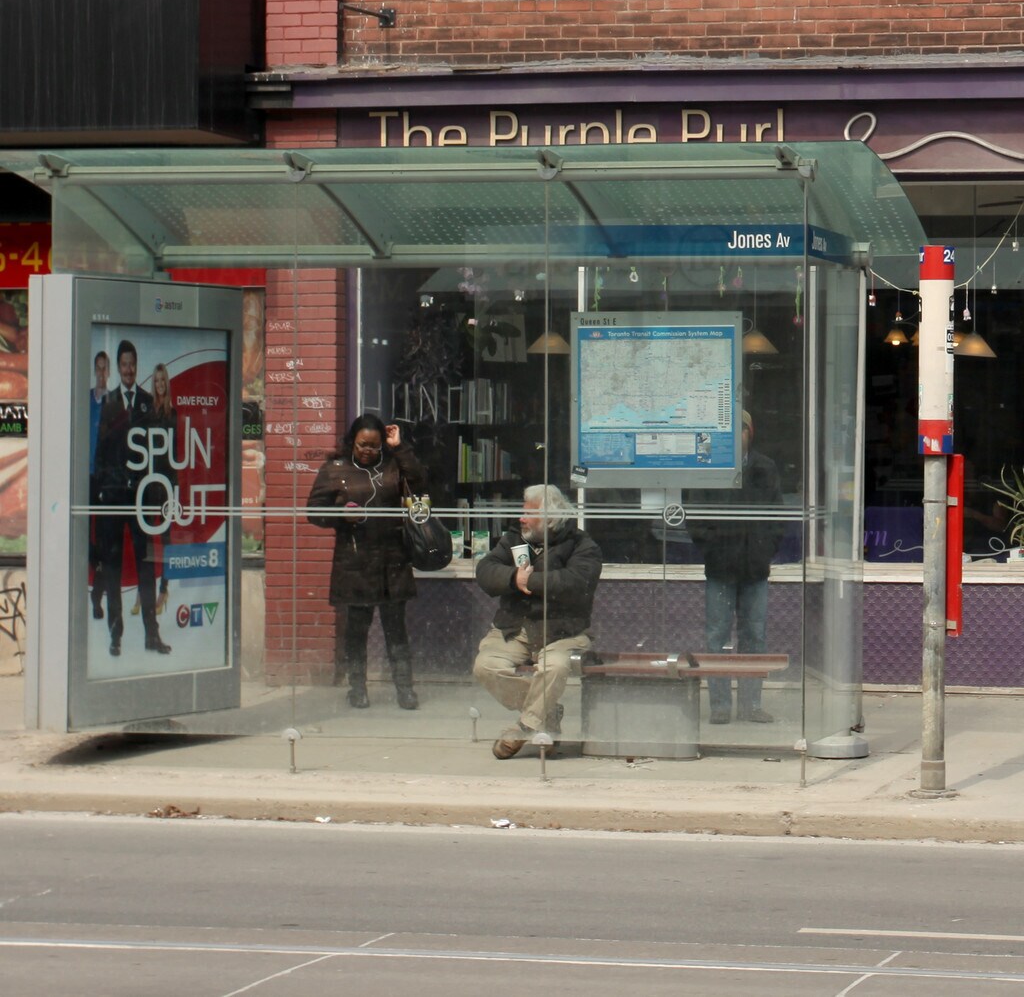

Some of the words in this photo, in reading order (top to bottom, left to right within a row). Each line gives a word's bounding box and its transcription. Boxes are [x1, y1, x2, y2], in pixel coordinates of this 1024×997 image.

[369, 111, 467, 147] The
[489, 109, 657, 146] Purple
[681, 108, 784, 143] Purl
[728, 230, 772, 249] Jones
[776, 234, 790, 248] Av
[811, 230, 822, 252] Jones
[164, 302, 182, 310] astral
[580, 318, 601, 326] Queen
[688, 331, 708, 339] System
[176, 396, 196, 406] DAVE
[197, 396, 219, 406] FOLEY
[242, 424, 262, 435] GES
[126, 416, 211, 475] SPUN
[136, 472, 226, 535] OUT
[169, 554, 207, 569] FRIDAYS
[208, 548, 219, 568] 8
[176, 602, 219, 628] CTV
